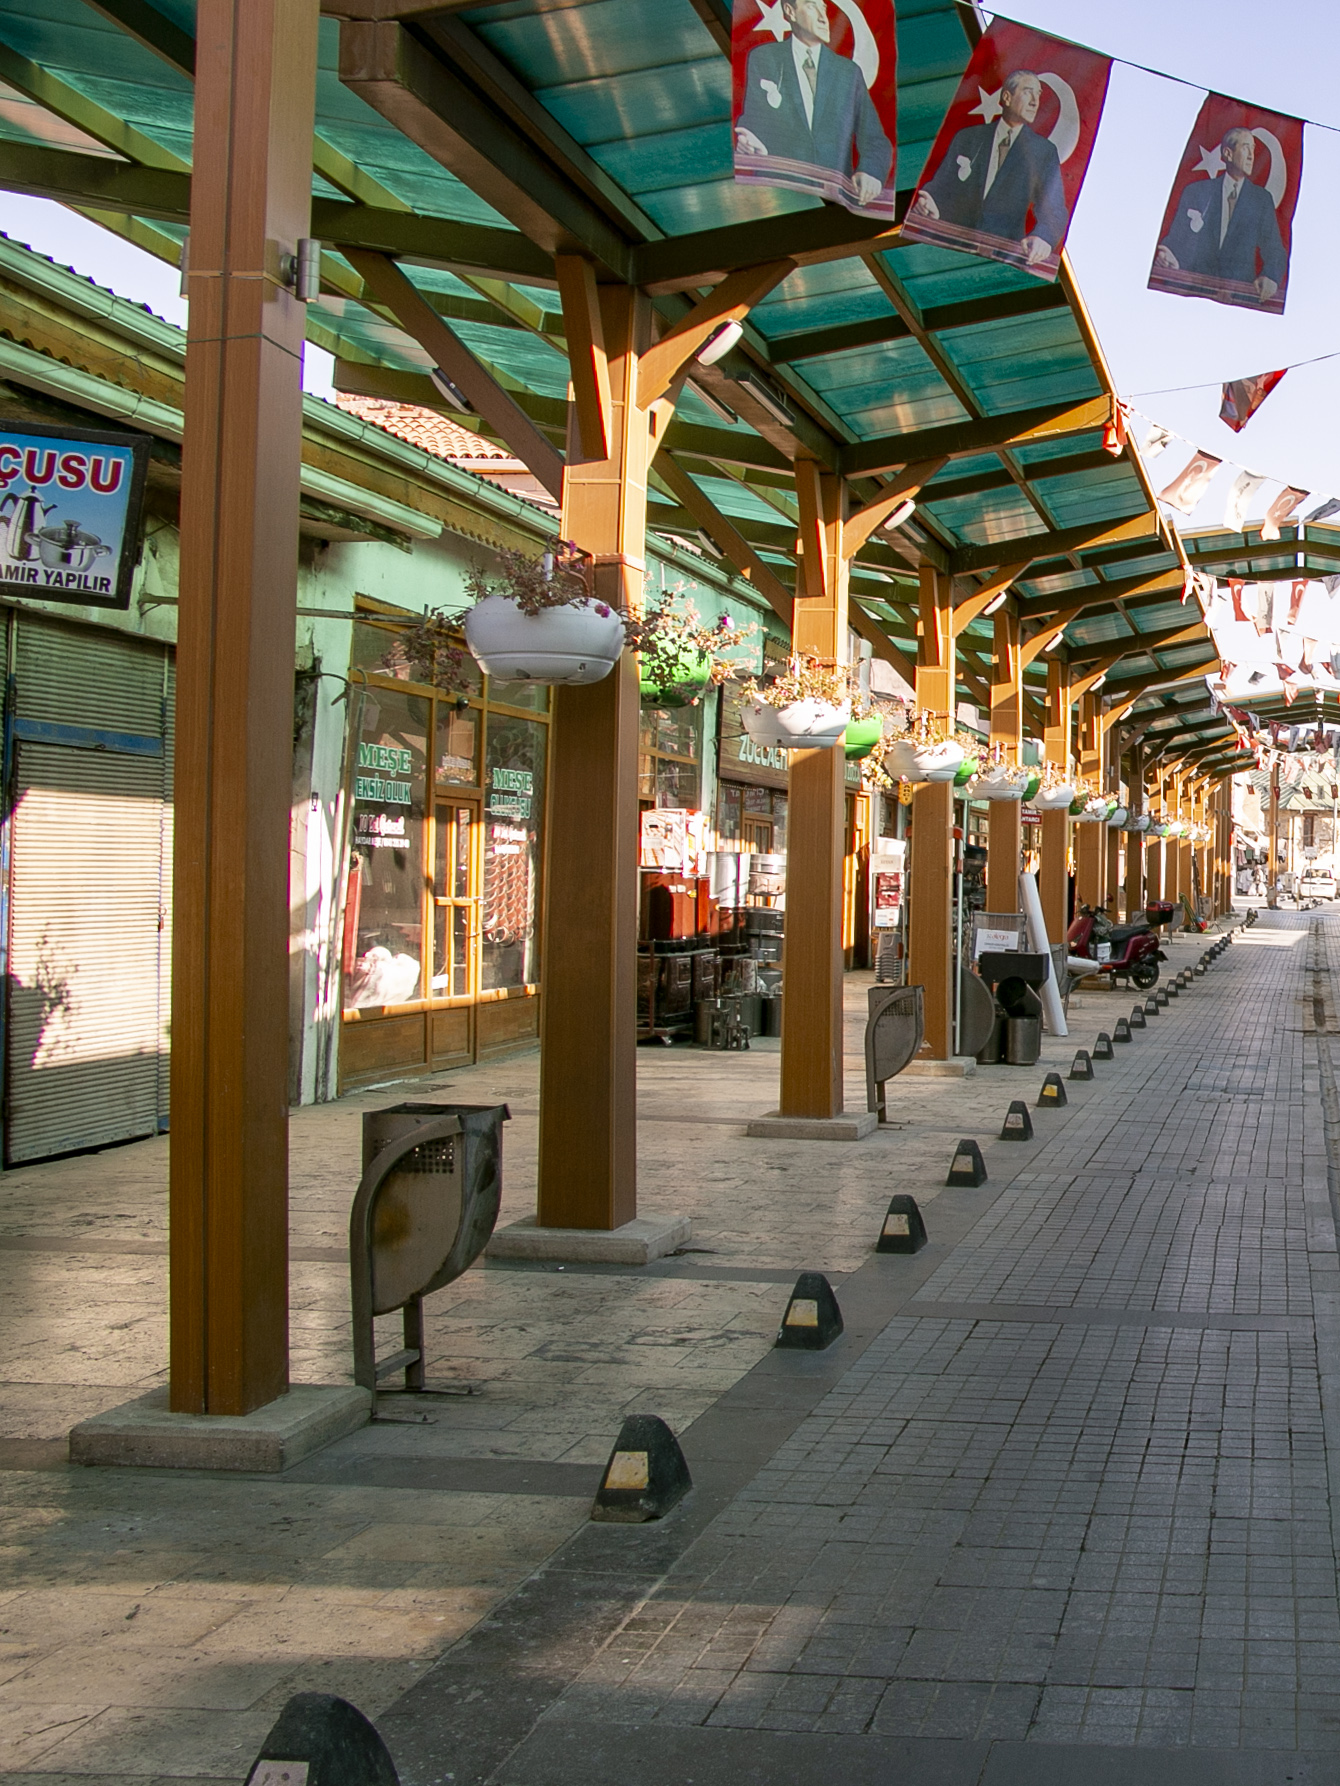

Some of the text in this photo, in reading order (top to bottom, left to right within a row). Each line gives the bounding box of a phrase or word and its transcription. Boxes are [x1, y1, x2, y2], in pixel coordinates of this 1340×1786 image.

[43, 569, 112, 593] YAPILIR
[358, 742, 412, 777] MEŞE
[386, 781, 412, 806] OLUK
[492, 768, 533, 796] MEŞE
